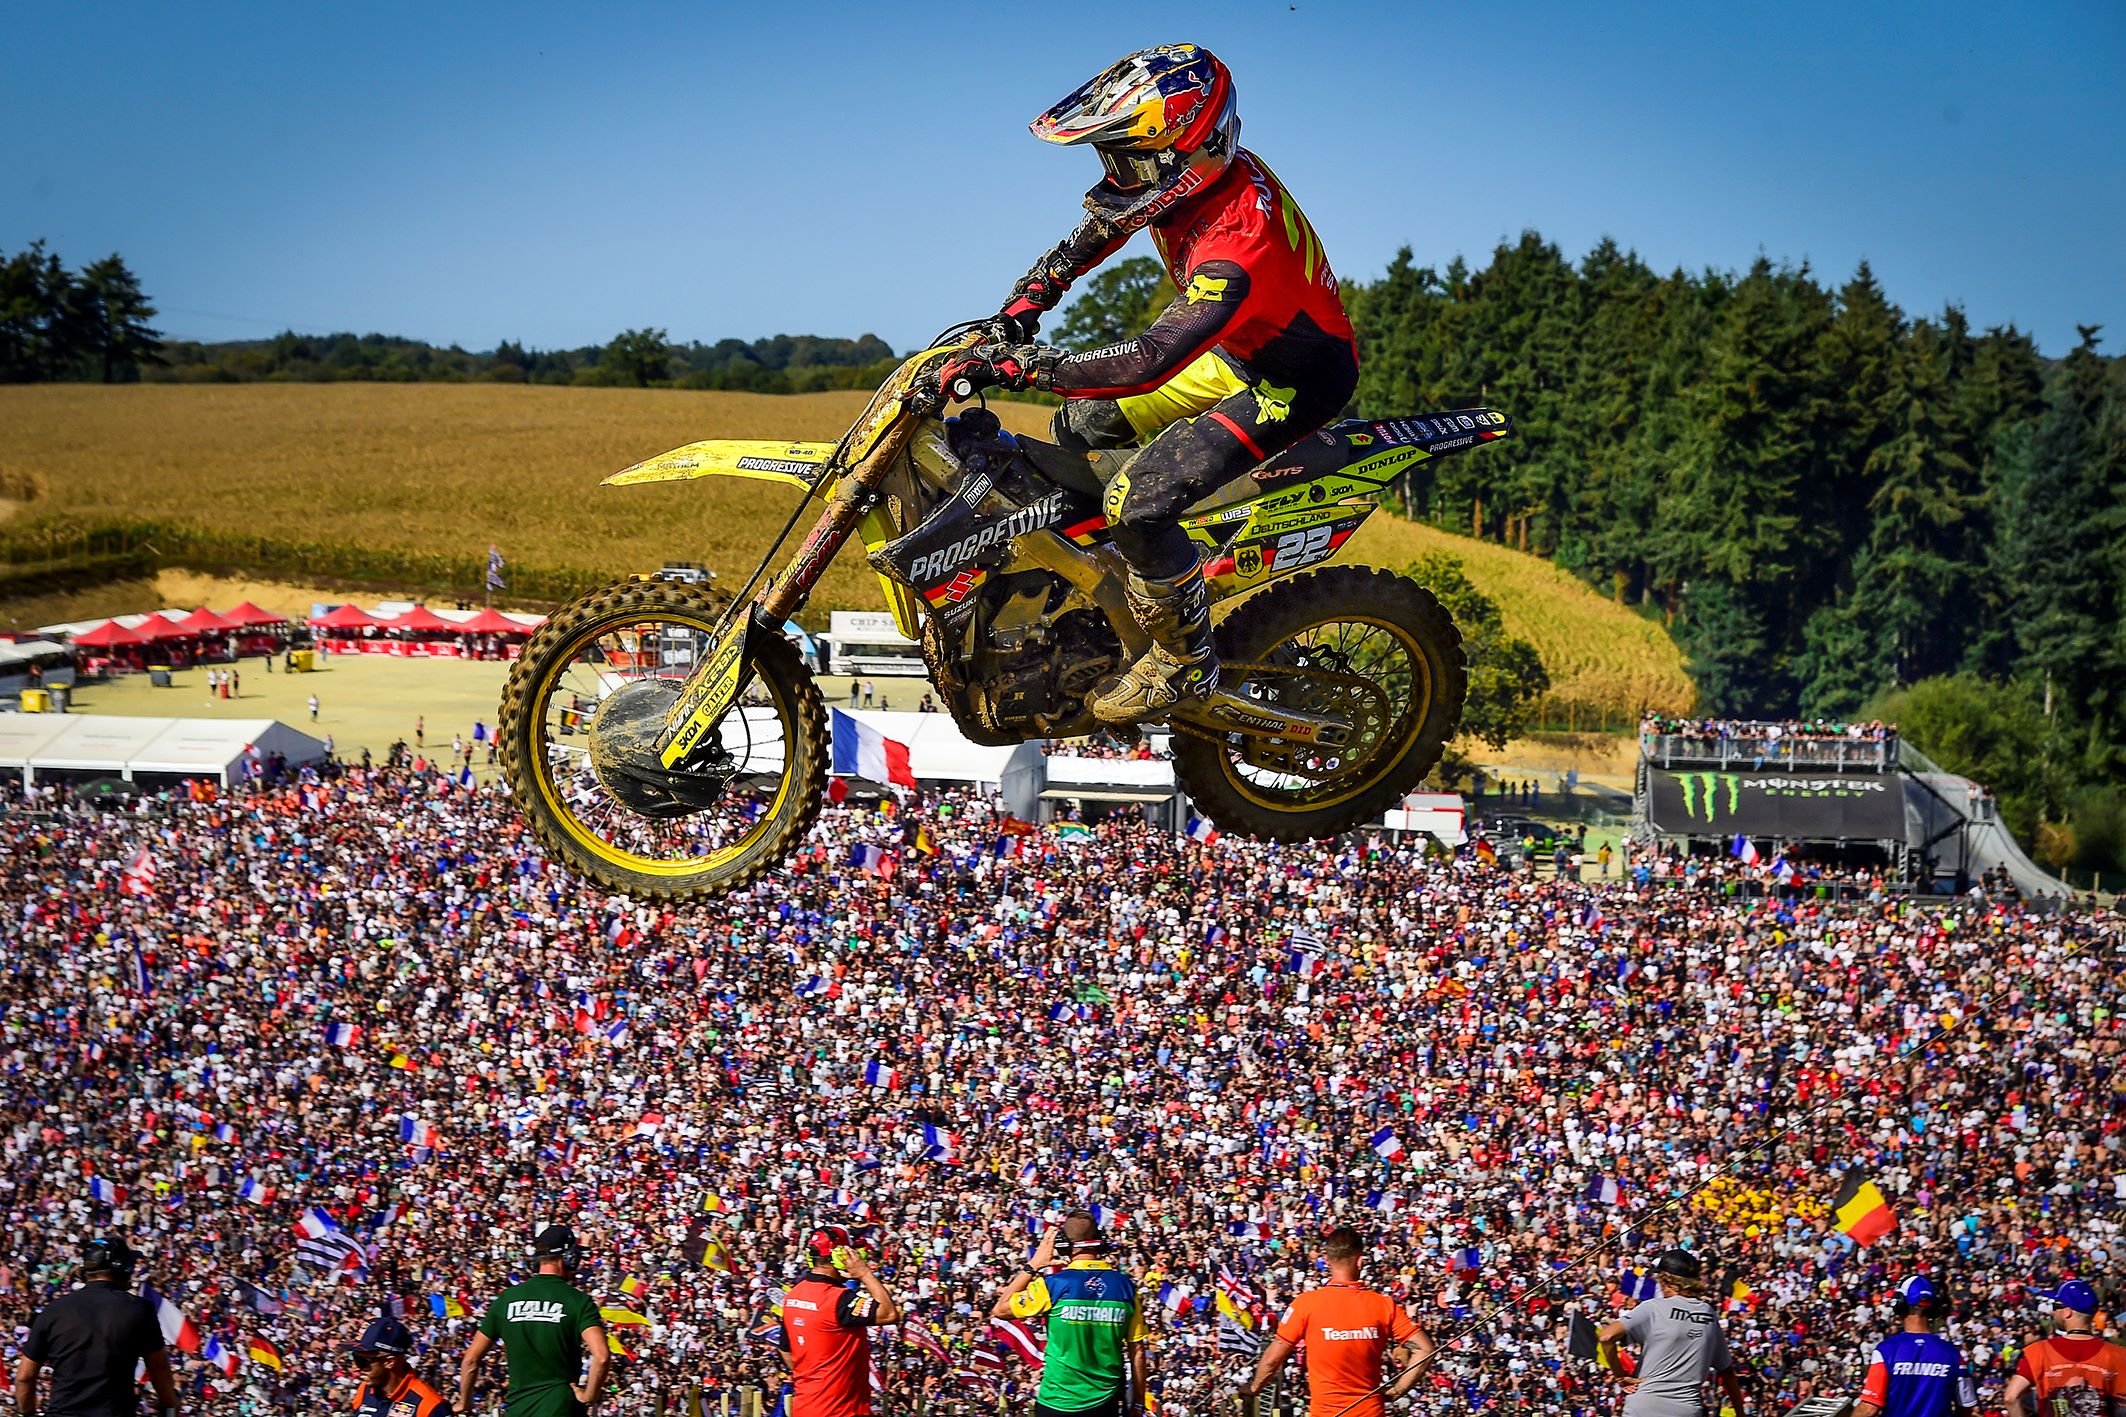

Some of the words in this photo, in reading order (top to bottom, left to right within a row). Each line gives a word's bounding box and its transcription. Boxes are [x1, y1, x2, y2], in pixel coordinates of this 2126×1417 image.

[1429, 436, 1474, 452] PROGRESSIVE
[737, 457, 815, 475] PROGRESSIVE
[1357, 450, 1417, 475] DUNLOP
[1252, 466, 1304, 480] GUTS
[967, 479, 990, 505] DIXXON
[1106, 483, 1126, 519] FOX
[1221, 507, 1252, 521] WPS
[1271, 526, 1332, 572] 22
[943, 597, 977, 619] SUZUKI
[702, 676, 735, 717] GALFER
[1290, 725, 1312, 736] DID
[1743, 778, 1885, 792] MONSTER
[1765, 788, 1864, 798] ENERGY
[507, 1300, 567, 1323] ITALIA
[1061, 1305, 1126, 1323] AUSTRALIA
[1893, 1362, 1951, 1377] FRANCE
